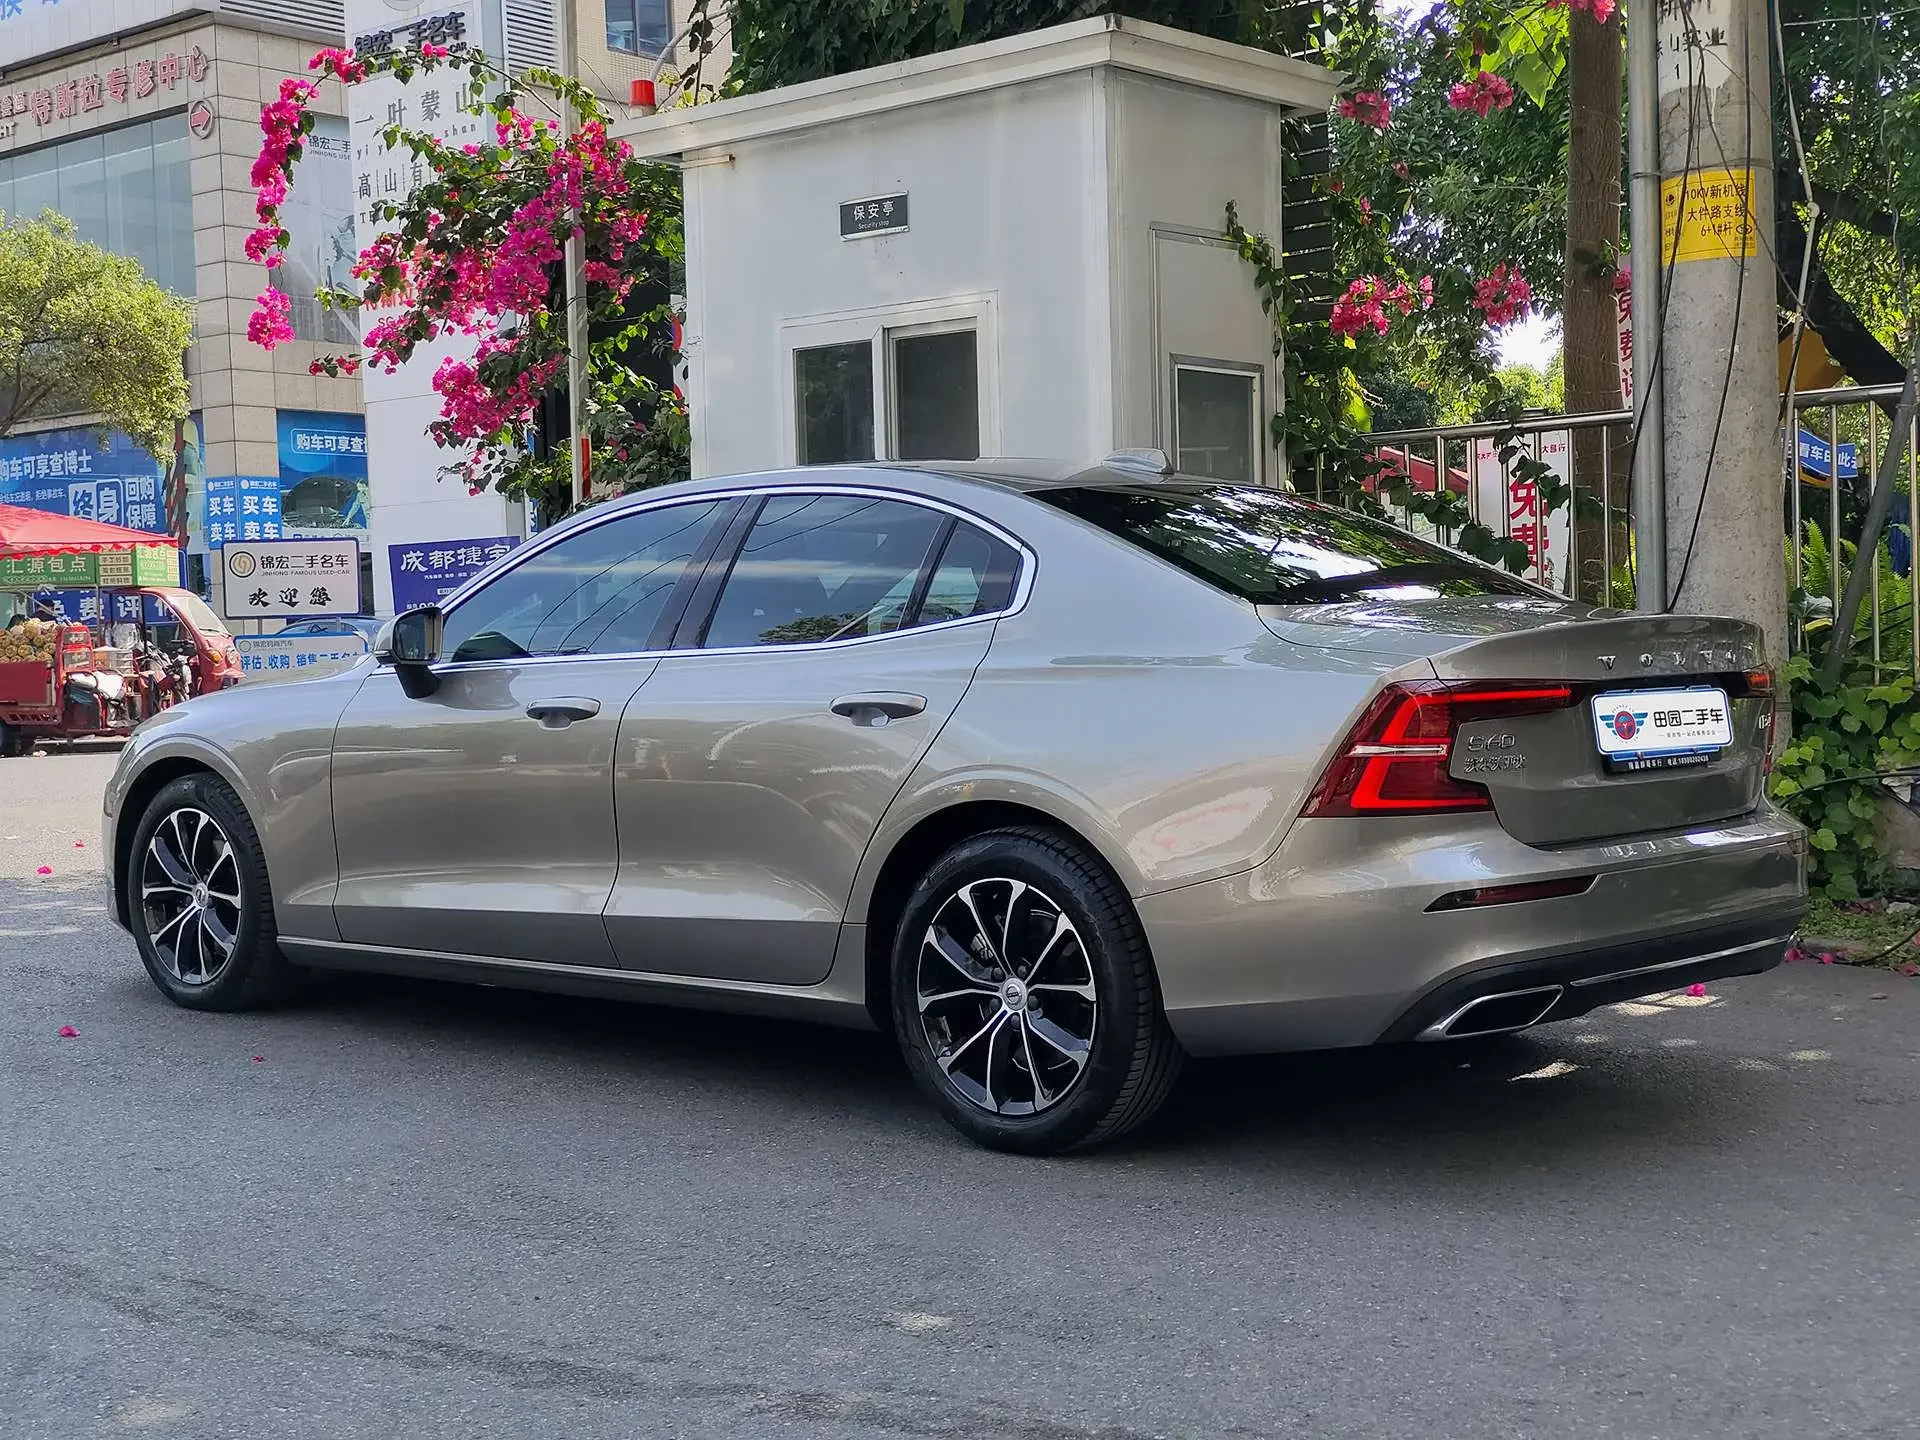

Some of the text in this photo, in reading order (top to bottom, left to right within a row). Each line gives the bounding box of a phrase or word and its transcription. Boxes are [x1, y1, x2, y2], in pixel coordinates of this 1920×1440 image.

[29, 45, 208, 125] 特斯拉专修中心
[355, 83, 475, 128] 一叶蒙山
[444, 123, 476, 137] shan
[360, 210, 383, 224] TE
[853, 200, 894, 221] 保安亭
[125, 476, 156, 501] 回购
[126, 502, 157, 529] 保障
[209, 496, 235, 517] 买车
[242, 495, 279, 516] 买车
[210, 521, 236, 542] 卖车
[244, 520, 280, 540] 卖车
[6, 556, 88, 574] 汇源包点
[260, 554, 349, 570] 锦宏二手名车
[248, 585, 332, 608] 欢迎您
[1597, 650, 1737, 671] VOLVO
[1653, 708, 1724, 728] 田园二手车
[1468, 734, 1516, 751] S60
